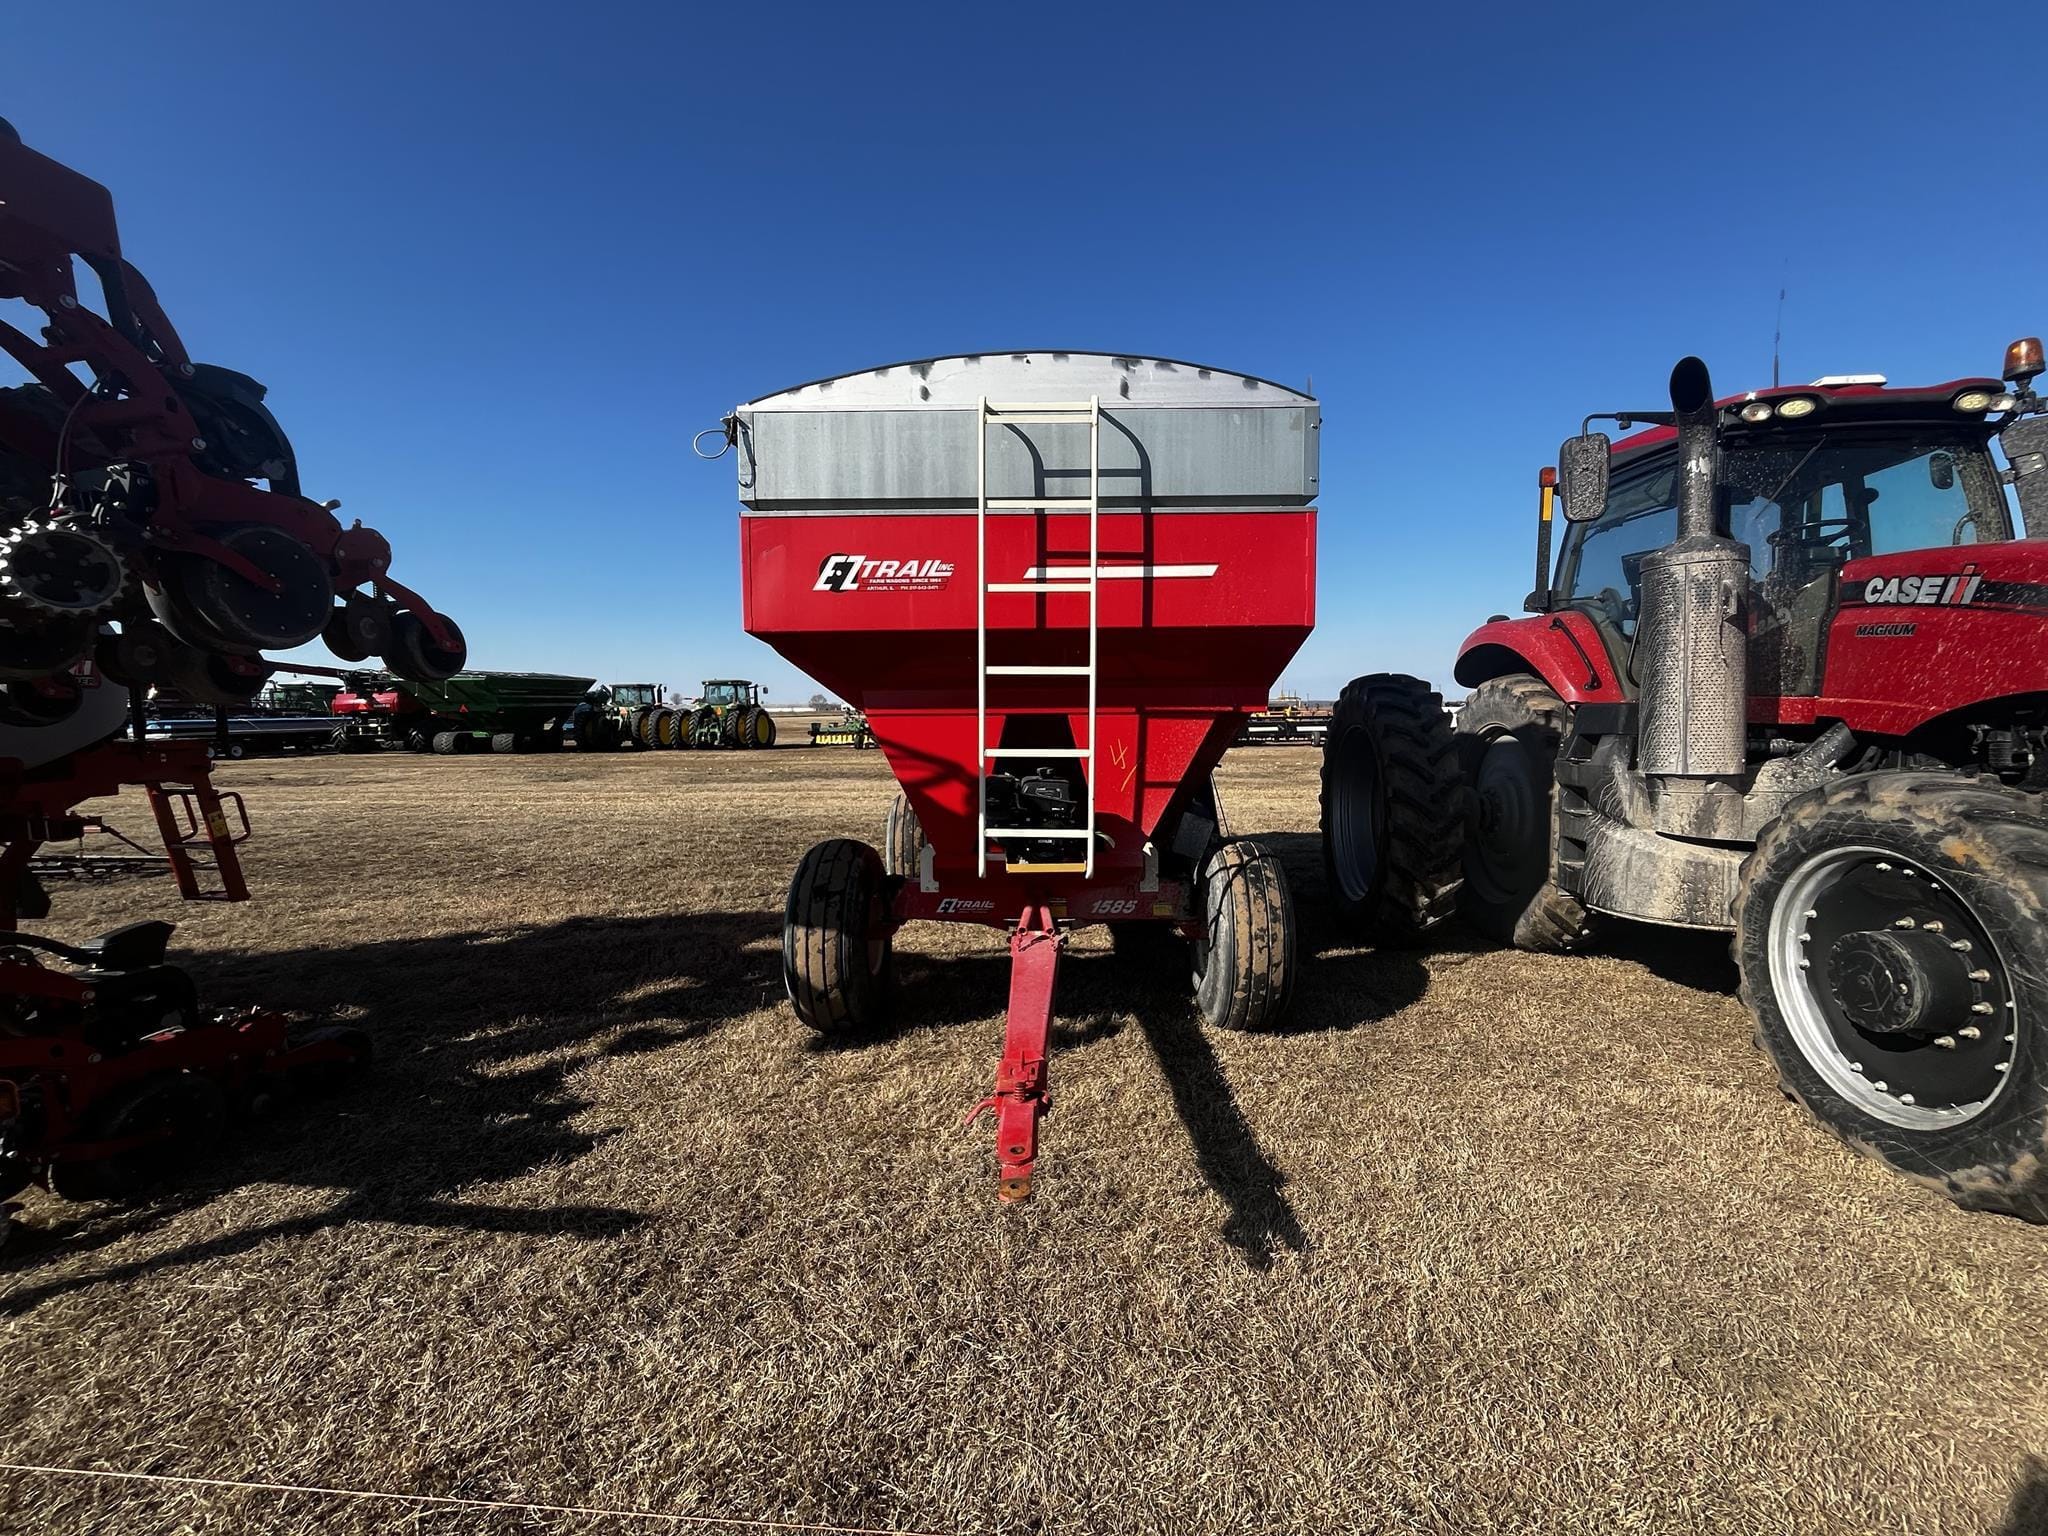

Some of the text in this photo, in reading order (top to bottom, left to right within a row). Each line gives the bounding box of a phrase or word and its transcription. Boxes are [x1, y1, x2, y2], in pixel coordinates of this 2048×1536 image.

[861, 560, 953, 578] TRAIL
[1864, 576, 1945, 604] CASE
[1856, 623, 1919, 637] MAGNUM
[956, 900, 994, 909] TRAIL
[1091, 900, 1138, 914] 1585
